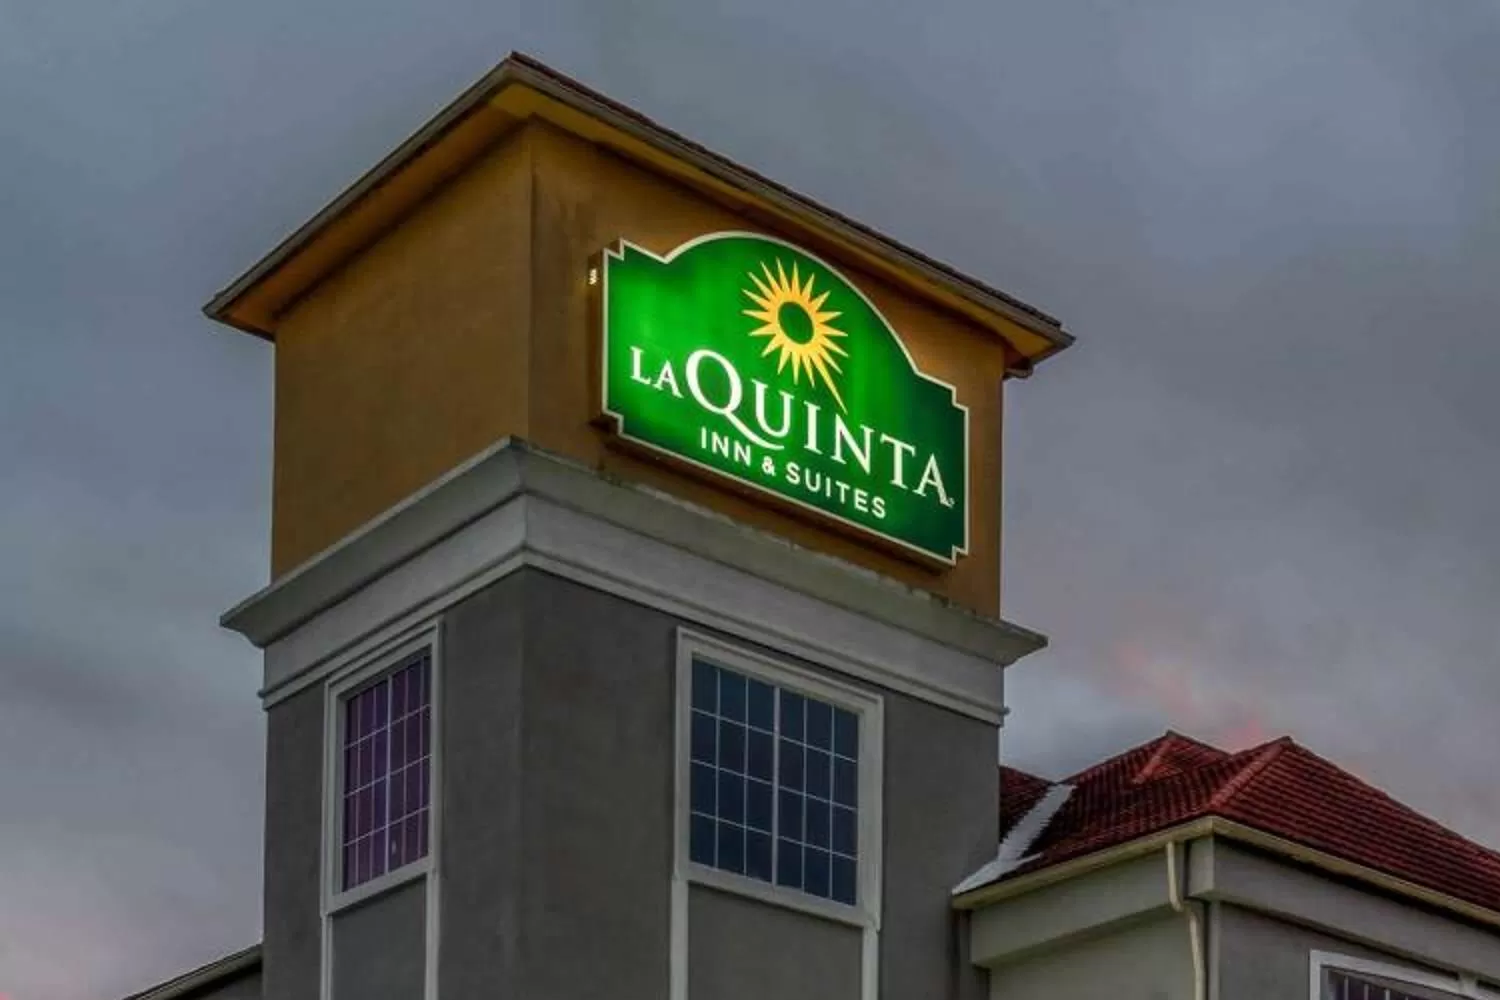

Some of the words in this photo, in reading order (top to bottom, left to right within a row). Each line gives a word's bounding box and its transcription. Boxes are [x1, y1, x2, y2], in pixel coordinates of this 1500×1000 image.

[630, 346, 683, 398] LA
[685, 349, 952, 506] QUINTA
[701, 426, 751, 466] INN
[761, 455, 776, 476] &
[785, 461, 886, 518] SUITES
